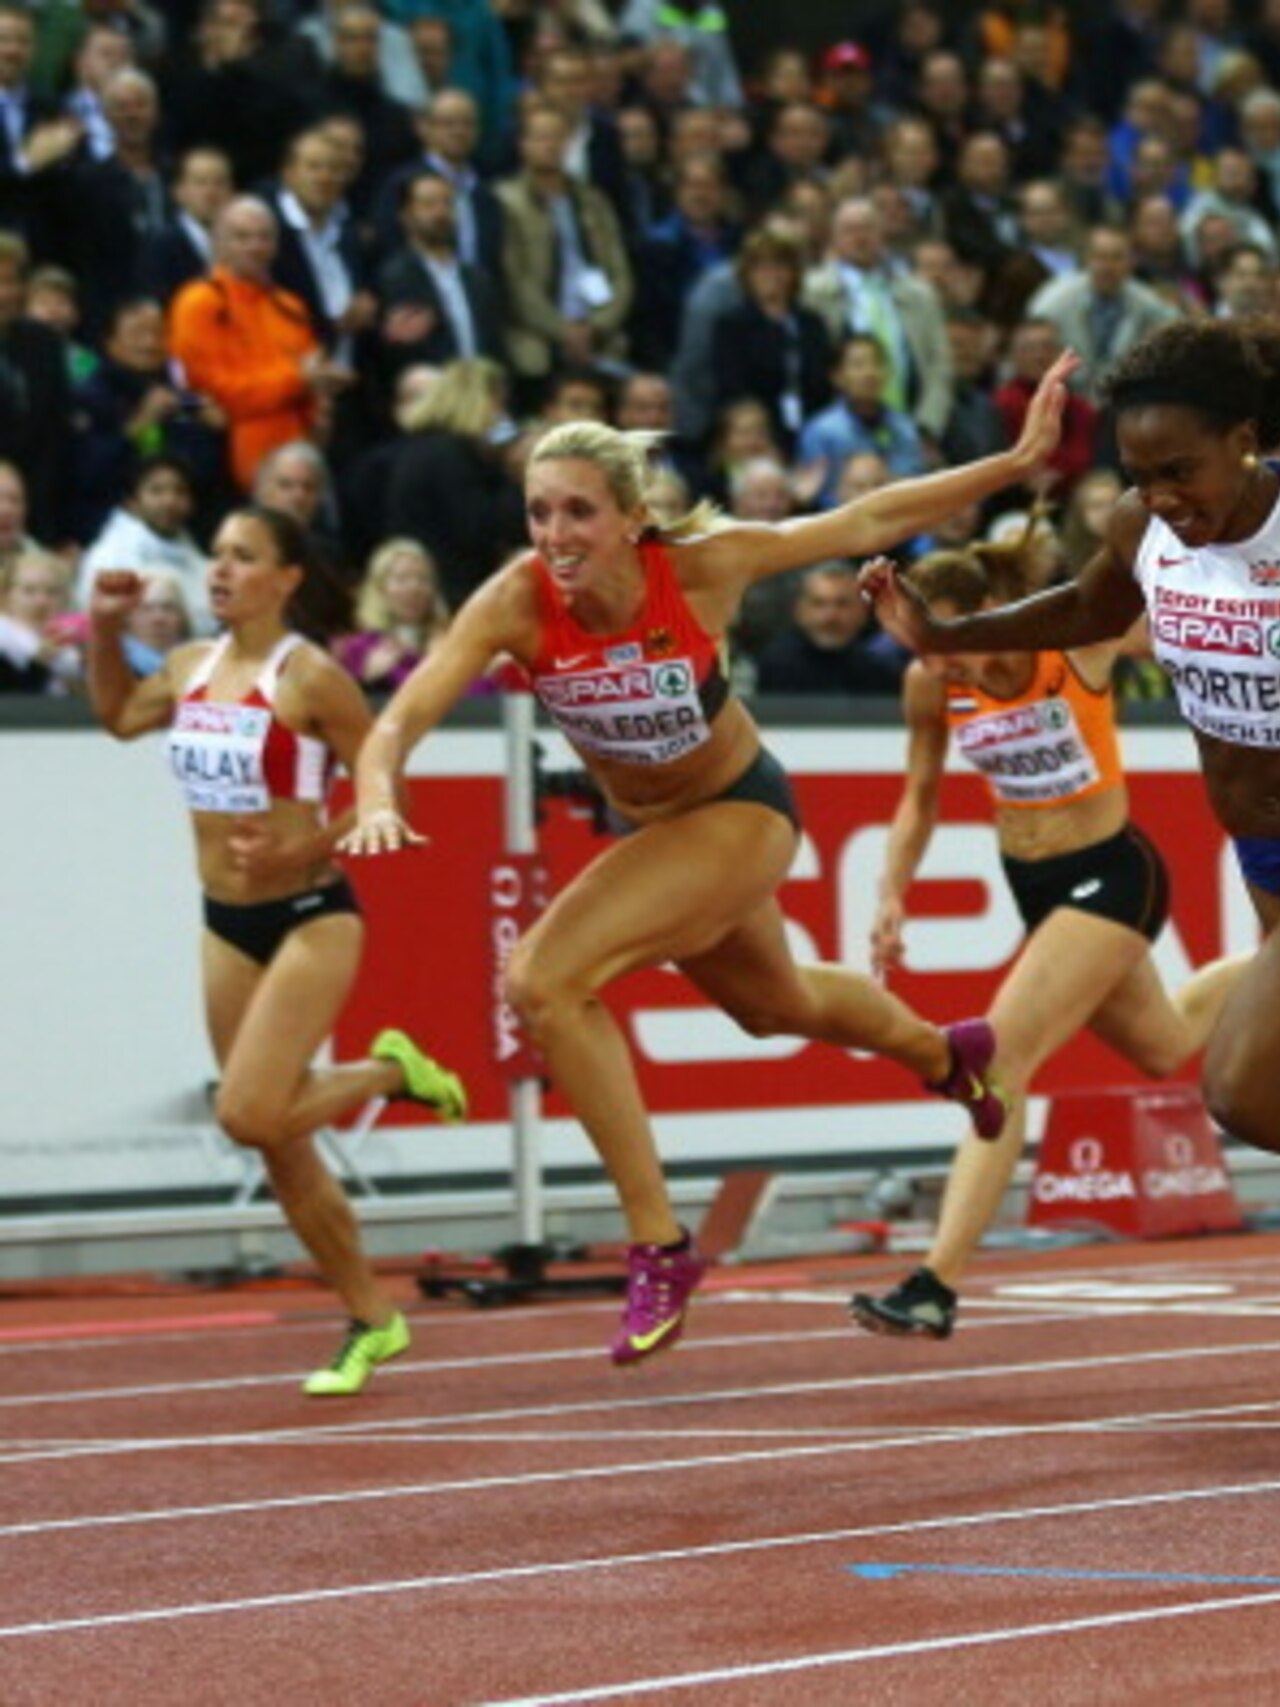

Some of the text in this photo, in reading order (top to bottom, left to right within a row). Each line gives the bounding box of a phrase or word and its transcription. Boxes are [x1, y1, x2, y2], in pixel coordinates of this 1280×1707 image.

[1156, 613, 1261, 651] SPAR
[536, 668, 650, 704] SPAR
[1035, 1172, 1136, 1203] OMEGA
